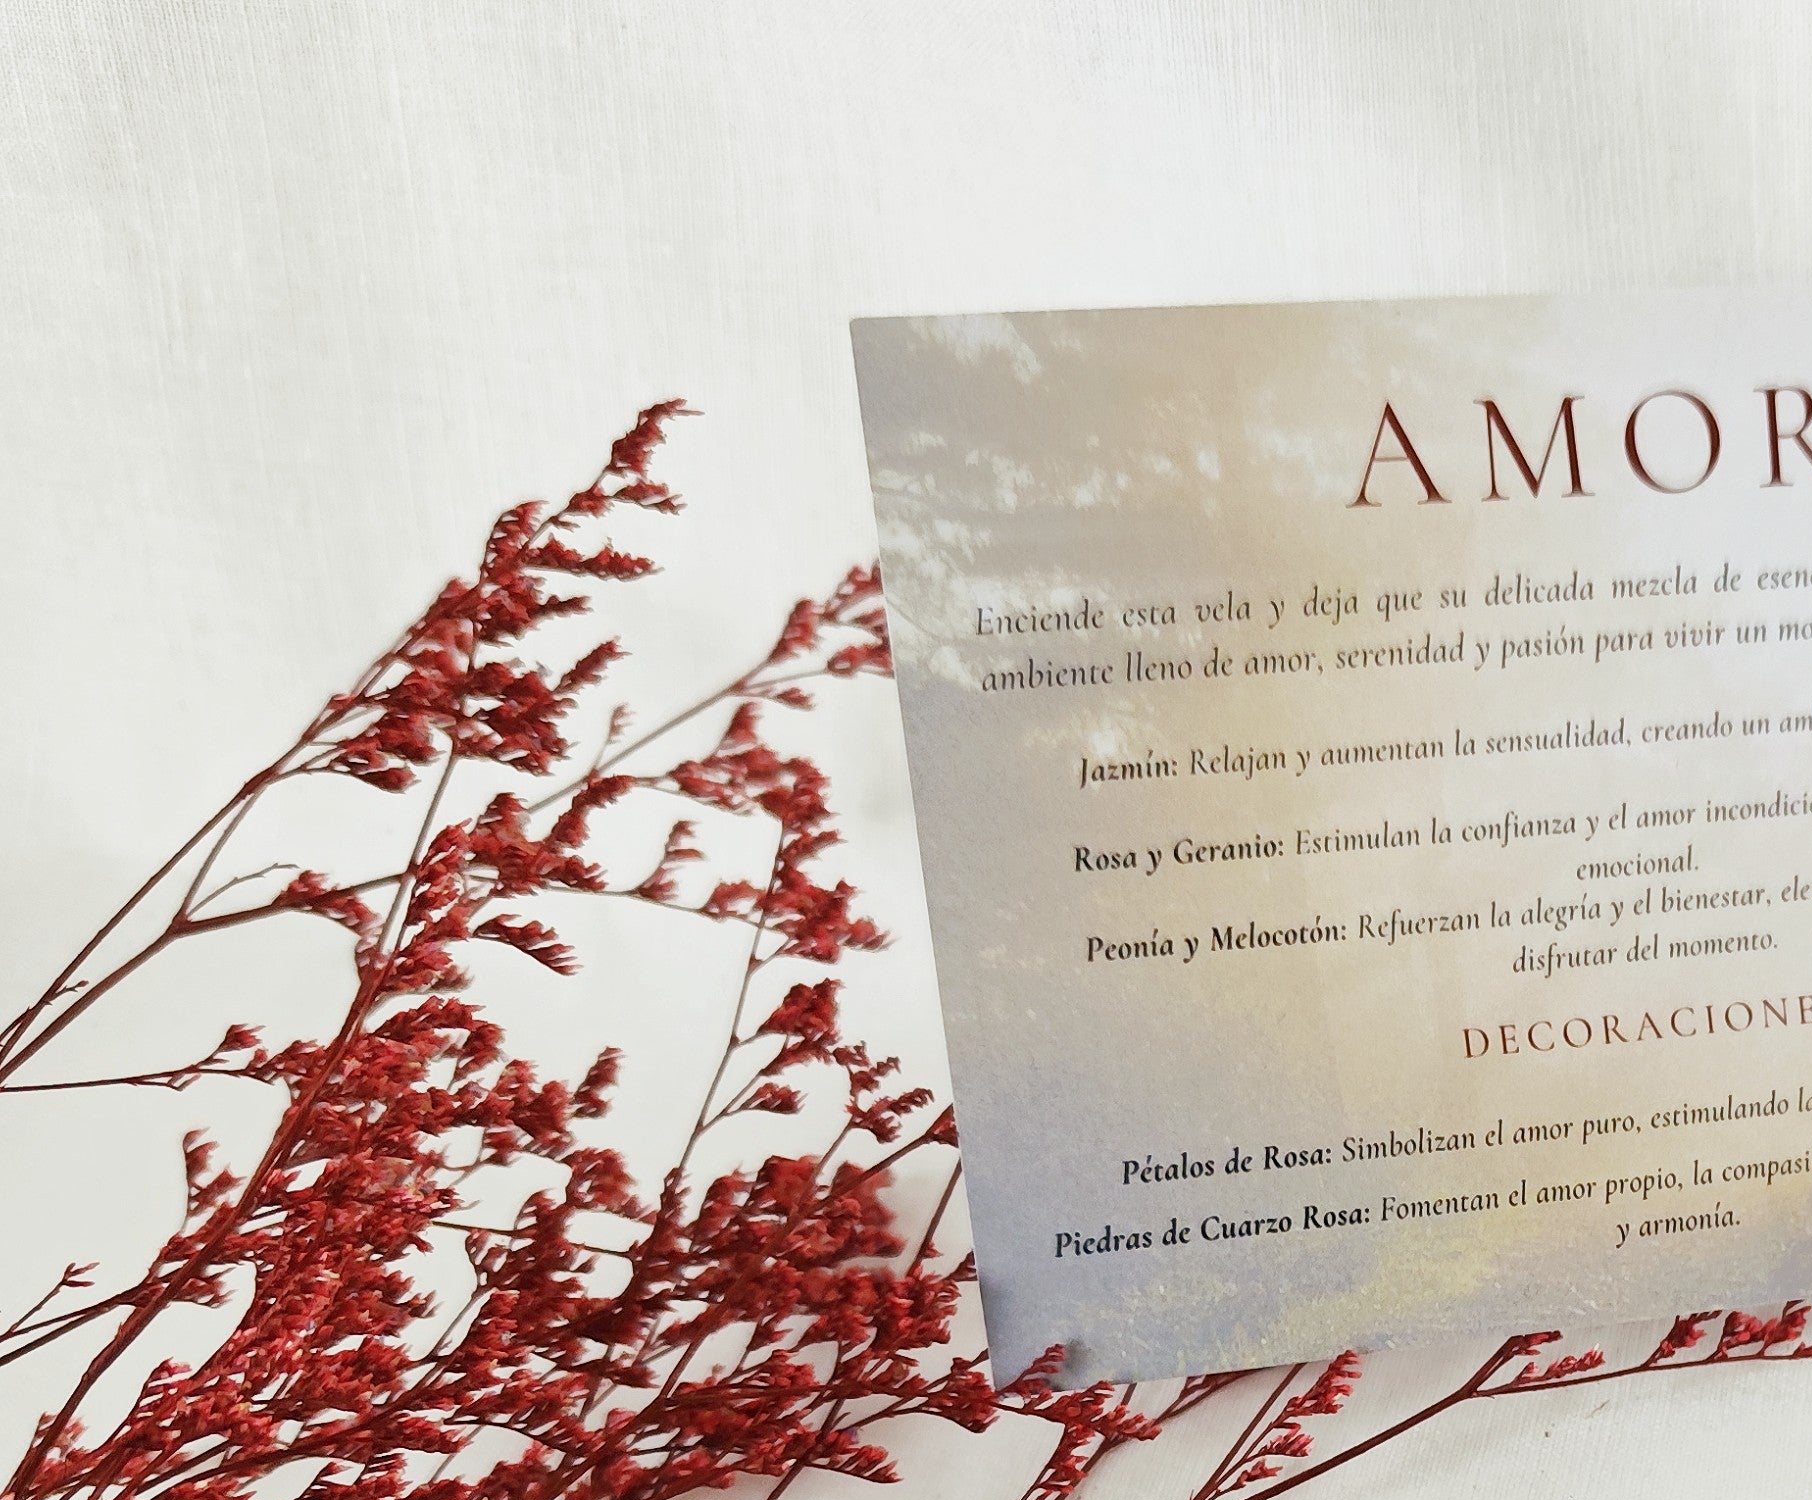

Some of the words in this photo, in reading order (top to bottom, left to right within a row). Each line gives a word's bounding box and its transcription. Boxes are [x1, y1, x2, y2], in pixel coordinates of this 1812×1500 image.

[975, 597, 1104, 636] Enciende
[1122, 605, 1177, 628] esta
[1194, 589, 1251, 623] vela
[1267, 599, 1285, 630] y
[1302, 584, 1359, 626] deja
[1376, 590, 1423, 623] que
[1439, 588, 1467, 610] su
[1484, 569, 1594, 607] delicada
[1611, 563, 1698, 599] mezcla
[1713, 561, 1742, 594] de
[981, 657, 1114, 692] ambiente
[1126, 650, 1193, 683] lleno
[1203, 645, 1234, 679] de
[1243, 651, 1324, 676] amor,
[1335, 629, 1465, 670] serenidad
[1473, 641, 1491, 672] y
[1500, 624, 1585, 670] pasión
[1594, 629, 1654, 664] para
[1663, 619, 1726, 649] vivir
[1736, 623, 1767, 645] un
[1079, 748, 1178, 790] Jazmín:
[1190, 743, 1287, 781] Relajan
[1295, 749, 1311, 778] y
[1320, 740, 1444, 767] aumentan
[1454, 728, 1476, 757] la
[1485, 716, 1632, 755] sensualidad,
[1641, 709, 1734, 744] creando
[1741, 717, 1770, 737] un
[1073, 846, 1138, 873] Rosa
[1145, 848, 1163, 877] y
[1172, 833, 1284, 865] Geranio:
[1296, 820, 1421, 856] Estimulan
[1431, 816, 1452, 845] la
[1461, 810, 1576, 849] confianza
[1584, 815, 1600, 843] y
[1608, 801, 1627, 831] el
[1636, 807, 1697, 829] amor
[1576, 843, 1699, 881] emocional.
[1086, 927, 1174, 963] Peonía
[1182, 936, 1200, 964] y
[1210, 914, 1347, 952] Melocotón:
[1358, 908, 1480, 947] Refuerzan
[1490, 900, 1511, 929] la
[1520, 892, 1602, 932] alegría
[1609, 900, 1625, 928] y
[1632, 887, 1652, 916] el
[1660, 885, 1772, 914] bienestar,
[1512, 941, 1618, 980] disfrutar
[1625, 932, 1659, 963] del
[1668, 933, 1778, 959] momento.
[1122, 1151, 1215, 1186] Pétalos
[1224, 1146, 1253, 1175] de
[1263, 1145, 1332, 1171] Rosa:
[1342, 1126, 1476, 1163] Simbolizan
[1484, 1118, 1504, 1147] el
[1512, 1121, 1574, 1145] amor
[1582, 1115, 1642, 1146] puro,
[1650, 1089, 1790, 1130] estimulando
[1054, 1224, 1153, 1259] Piedras
[1161, 1217, 1191, 1247] de
[1200, 1215, 1293, 1242] Cuarzo
[1303, 1204, 1370, 1230] Rosa:
[1380, 1192, 1500, 1222] Fomentan
[1508, 1178, 1527, 1208] el
[1536, 1181, 1597, 1205] amor
[1604, 1167, 1684, 1205] propio,
[1693, 1159, 1713, 1186] la
[1615, 1222, 1630, 1250] y
[1638, 1201, 1741, 1238] armonía.
